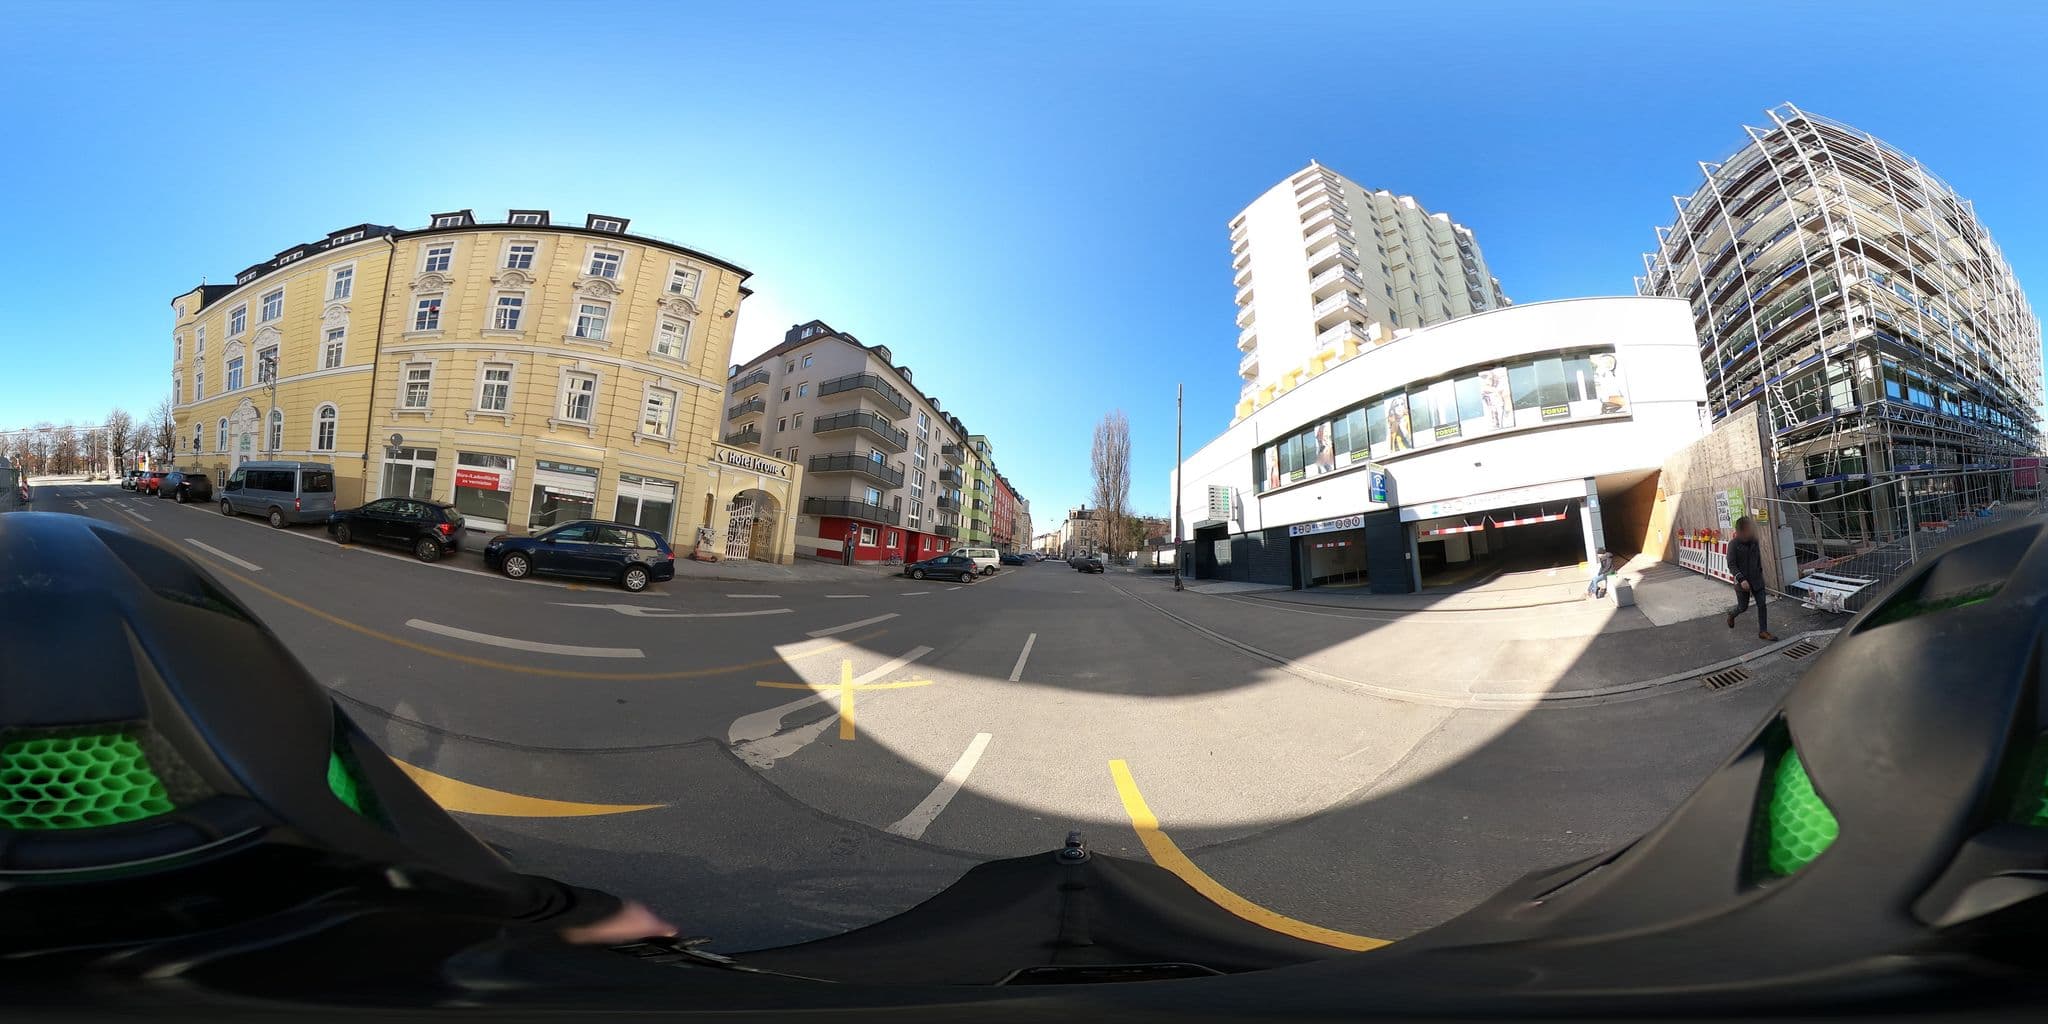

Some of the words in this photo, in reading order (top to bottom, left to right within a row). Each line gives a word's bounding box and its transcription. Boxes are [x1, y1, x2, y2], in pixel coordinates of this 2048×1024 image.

[1542, 406, 1568, 415] FORUM
[1436, 427, 1458, 438] FORUM
[728, 451, 753, 468] Hotel
[753, 457, 780, 475] Krone
